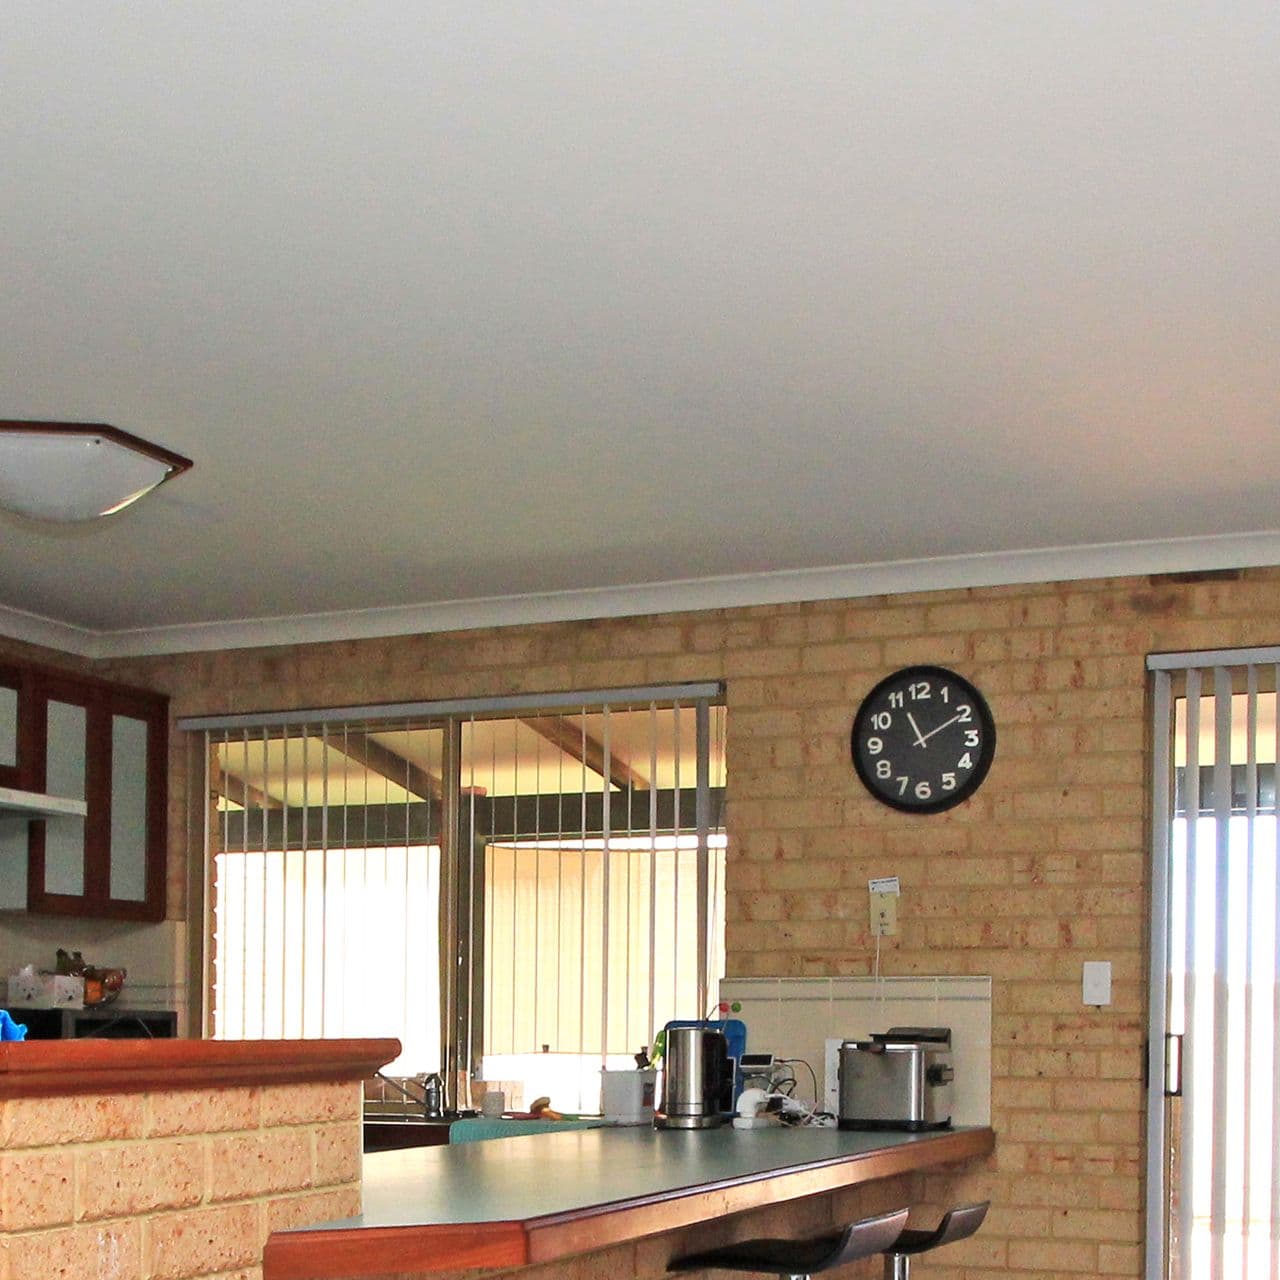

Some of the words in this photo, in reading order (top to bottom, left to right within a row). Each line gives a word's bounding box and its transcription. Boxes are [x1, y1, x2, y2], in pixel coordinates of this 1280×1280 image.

[888, 691, 904, 708] 11
[908, 682, 931, 700] 12
[940, 686, 949, 703] 1
[870, 711, 892, 730] 10
[956, 704, 972, 723] 2
[867, 737, 883, 754] 9
[964, 729, 979, 747] 3
[876, 760, 891, 779] 8
[957, 752, 973, 770] 4
[896, 776, 908, 796] 7
[915, 781, 932, 799] 6
[941, 772, 957, 791] 5
